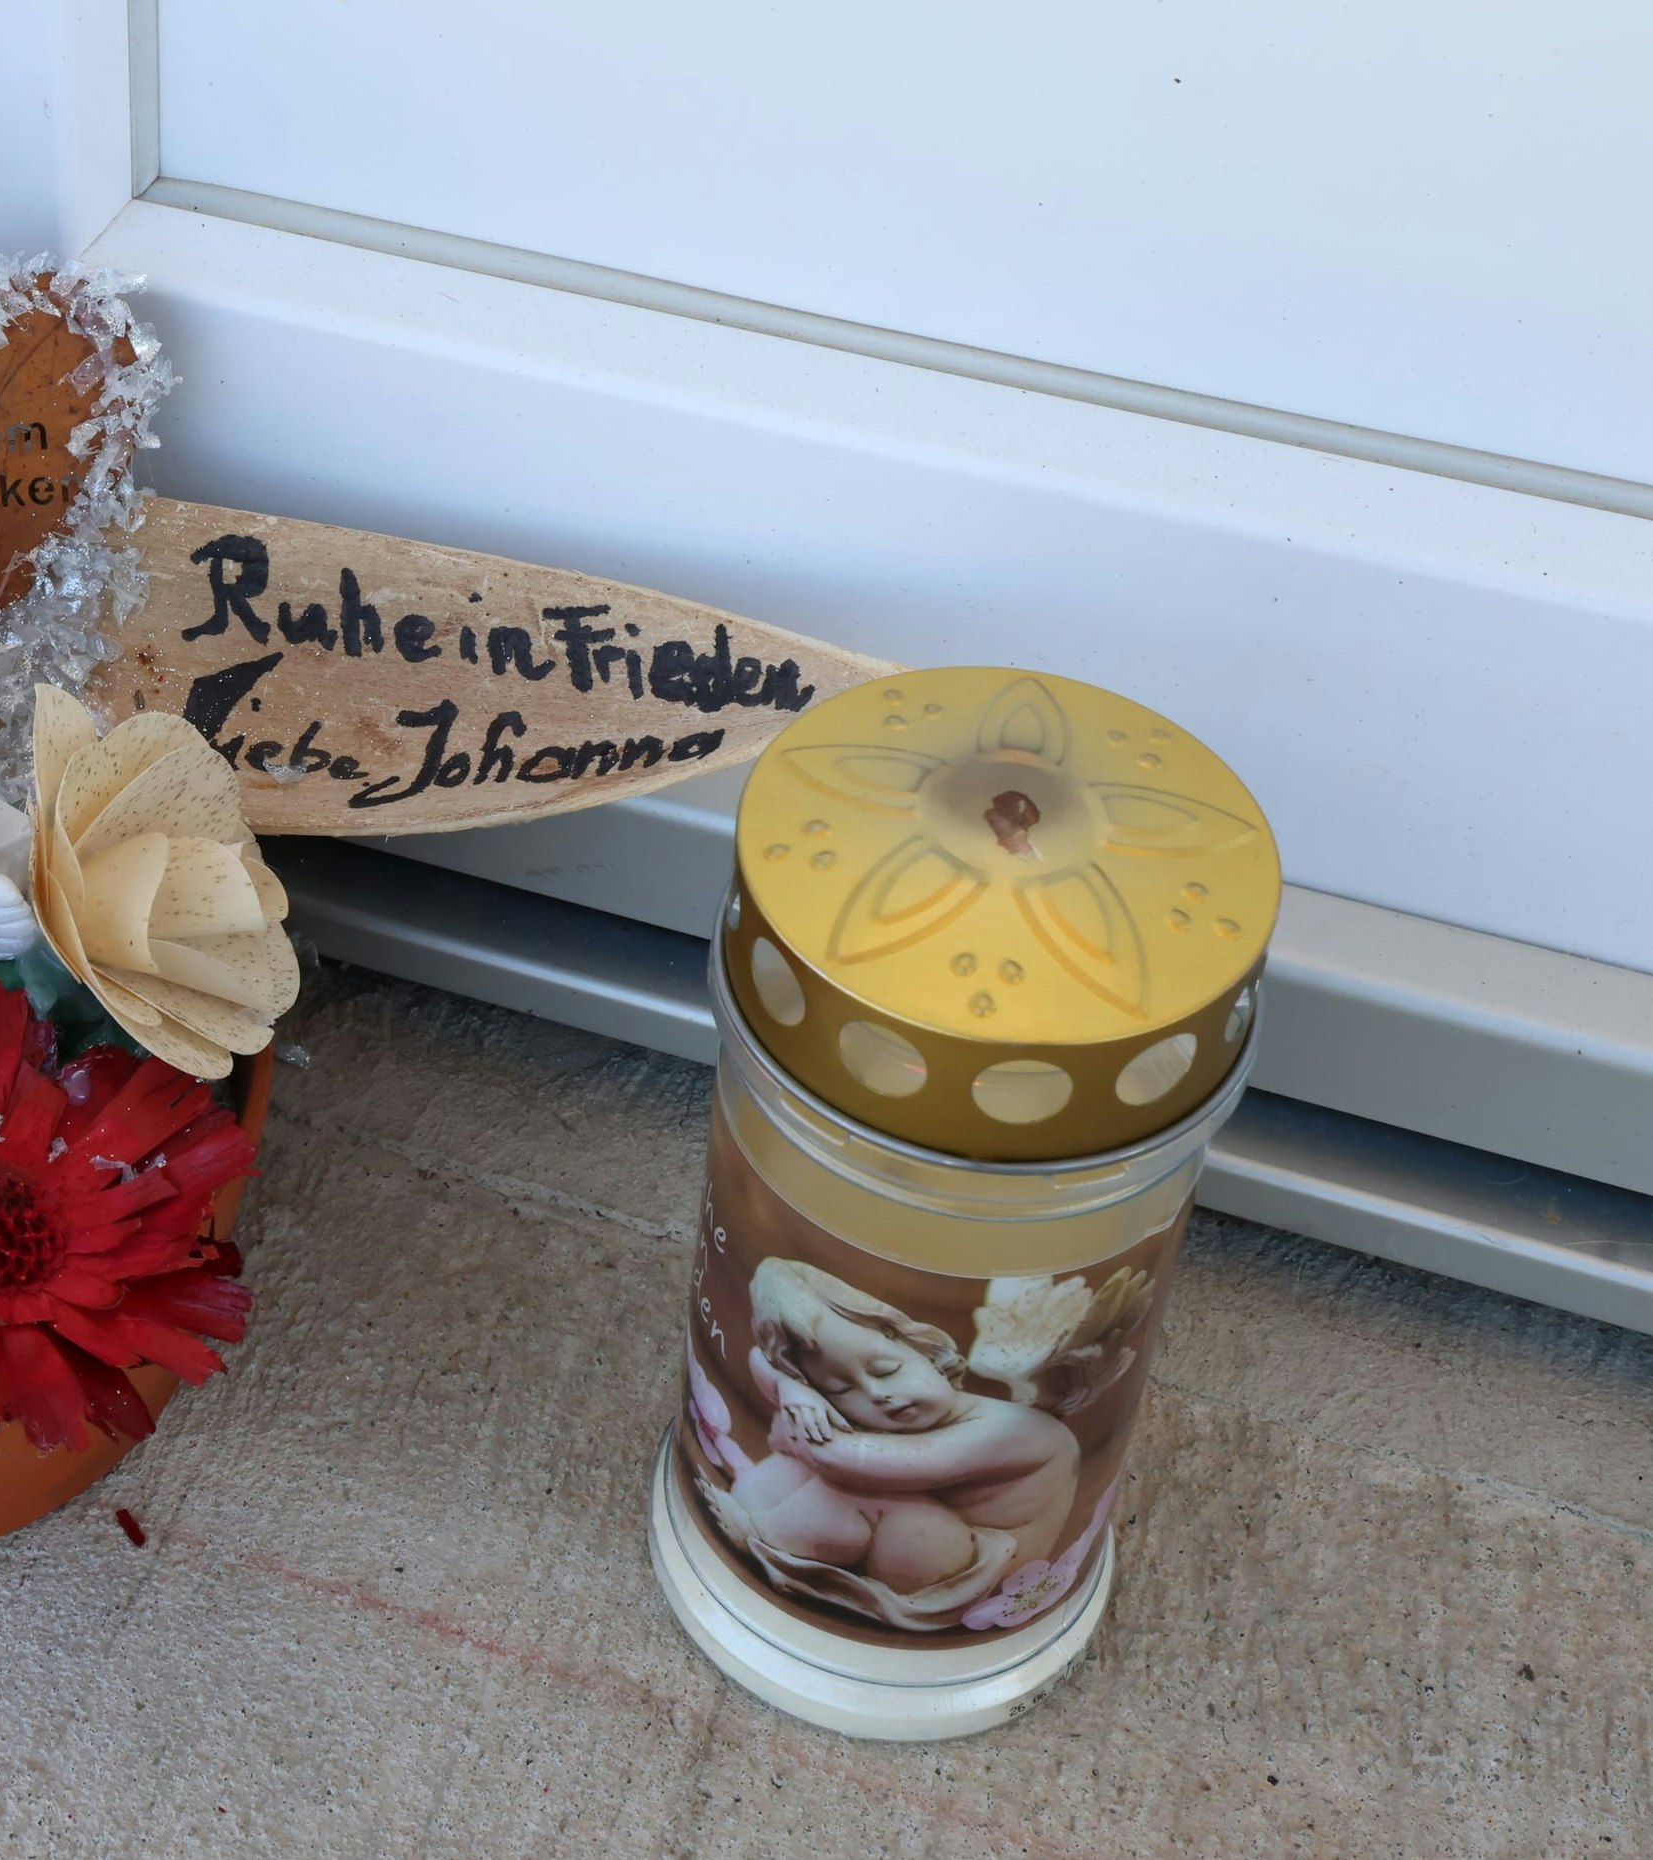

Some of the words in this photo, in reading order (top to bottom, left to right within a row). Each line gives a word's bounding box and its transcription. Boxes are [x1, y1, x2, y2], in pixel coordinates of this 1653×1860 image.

[181, 533, 443, 663] Ruhe
[459, 592, 557, 681] in
[542, 604, 816, 714] Frieden
[348, 699, 726, 809] Johanna
